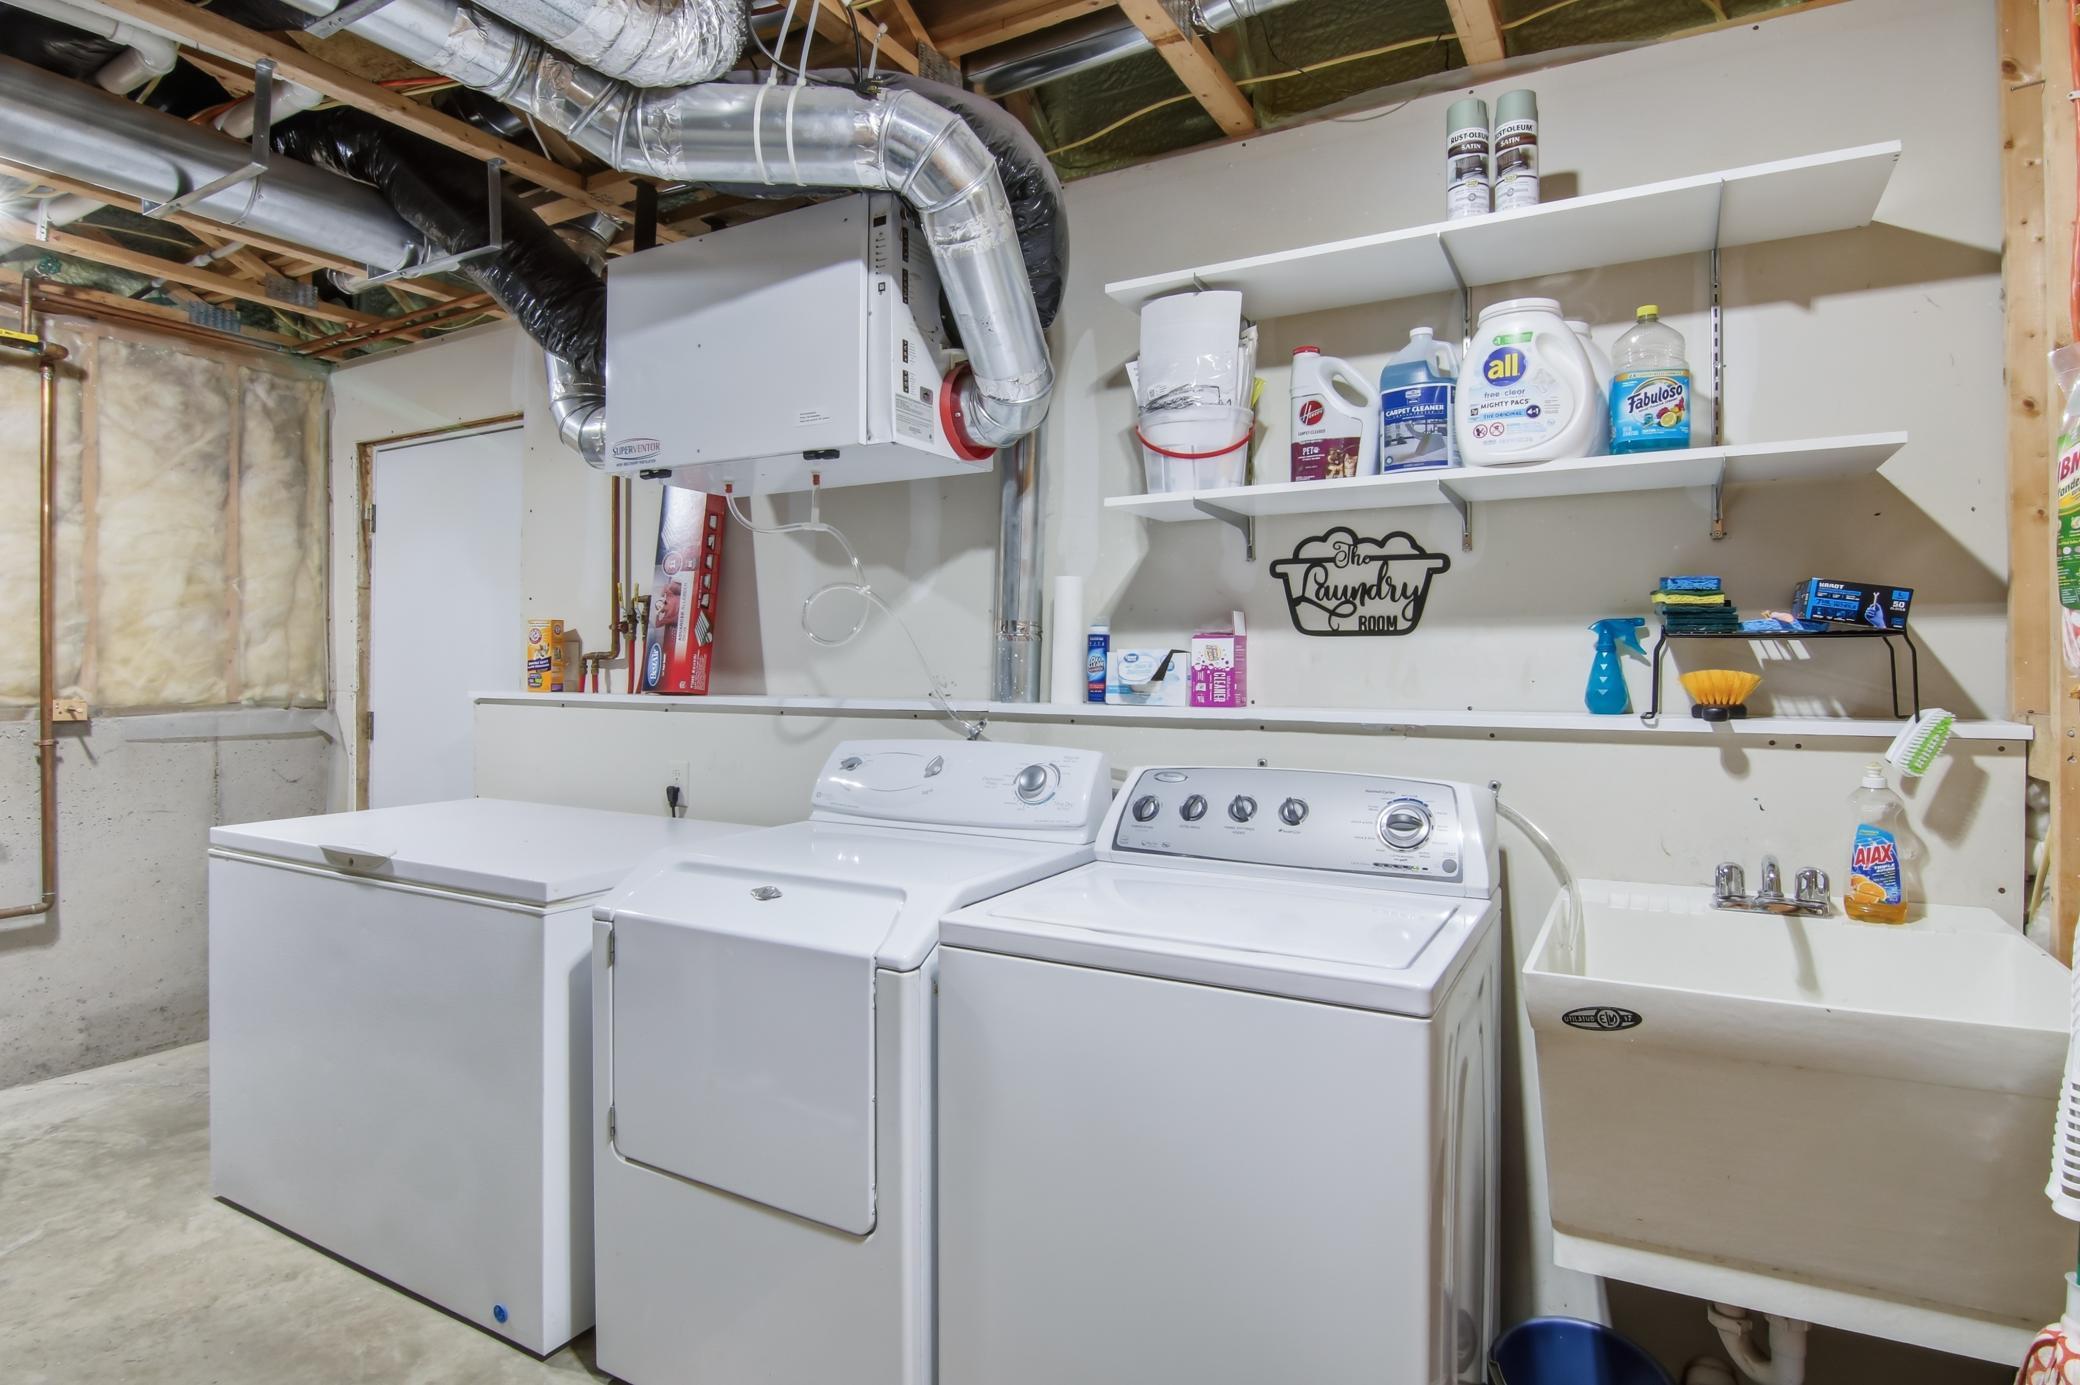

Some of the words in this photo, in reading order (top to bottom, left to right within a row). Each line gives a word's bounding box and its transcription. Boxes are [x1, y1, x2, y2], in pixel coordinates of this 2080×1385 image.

[1500, 136, 1520, 147] SATIN
[1488, 353, 1519, 379] all
[1484, 391, 1500, 399] free
[1627, 384, 1682, 413] Fabuloso
[1386, 407, 1411, 417] CARPET
[1411, 404, 1444, 412] CLEANER
[1481, 400, 1509, 409] MIGHTY
[1510, 398, 1529, 406] PACS
[1302, 446, 1314, 456] PET
[1333, 541, 1371, 568] The
[1295, 560, 1419, 625] Laundry
[1892, 600, 1905, 608] 50
[1358, 615, 1398, 631] ROOM
[1213, 672, 1226, 703] CLEANER
[1854, 843, 1893, 869] AJAX
